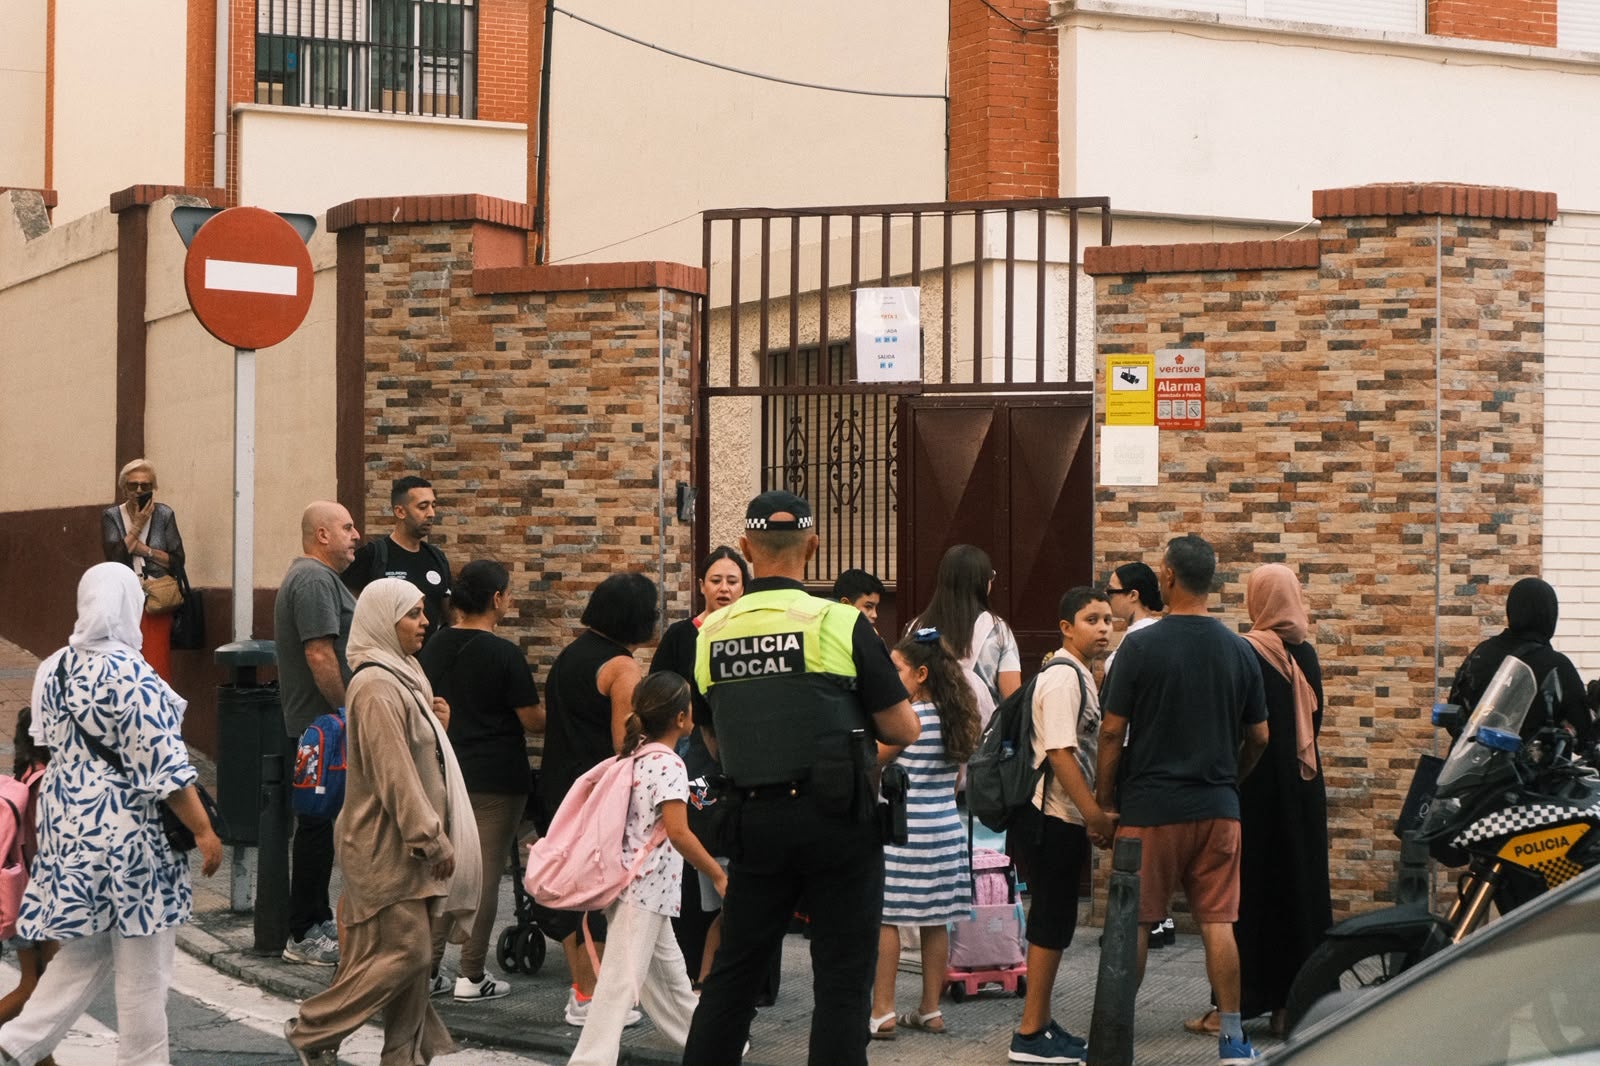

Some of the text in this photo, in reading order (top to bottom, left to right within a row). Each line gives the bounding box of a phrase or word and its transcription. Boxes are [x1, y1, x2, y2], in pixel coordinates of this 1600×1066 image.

[1158, 381, 1201, 391] Alarma
[712, 634, 800, 658] POLICIA
[720, 656, 792, 678] LOCAL
[1514, 836, 1570, 857] POLICIA
